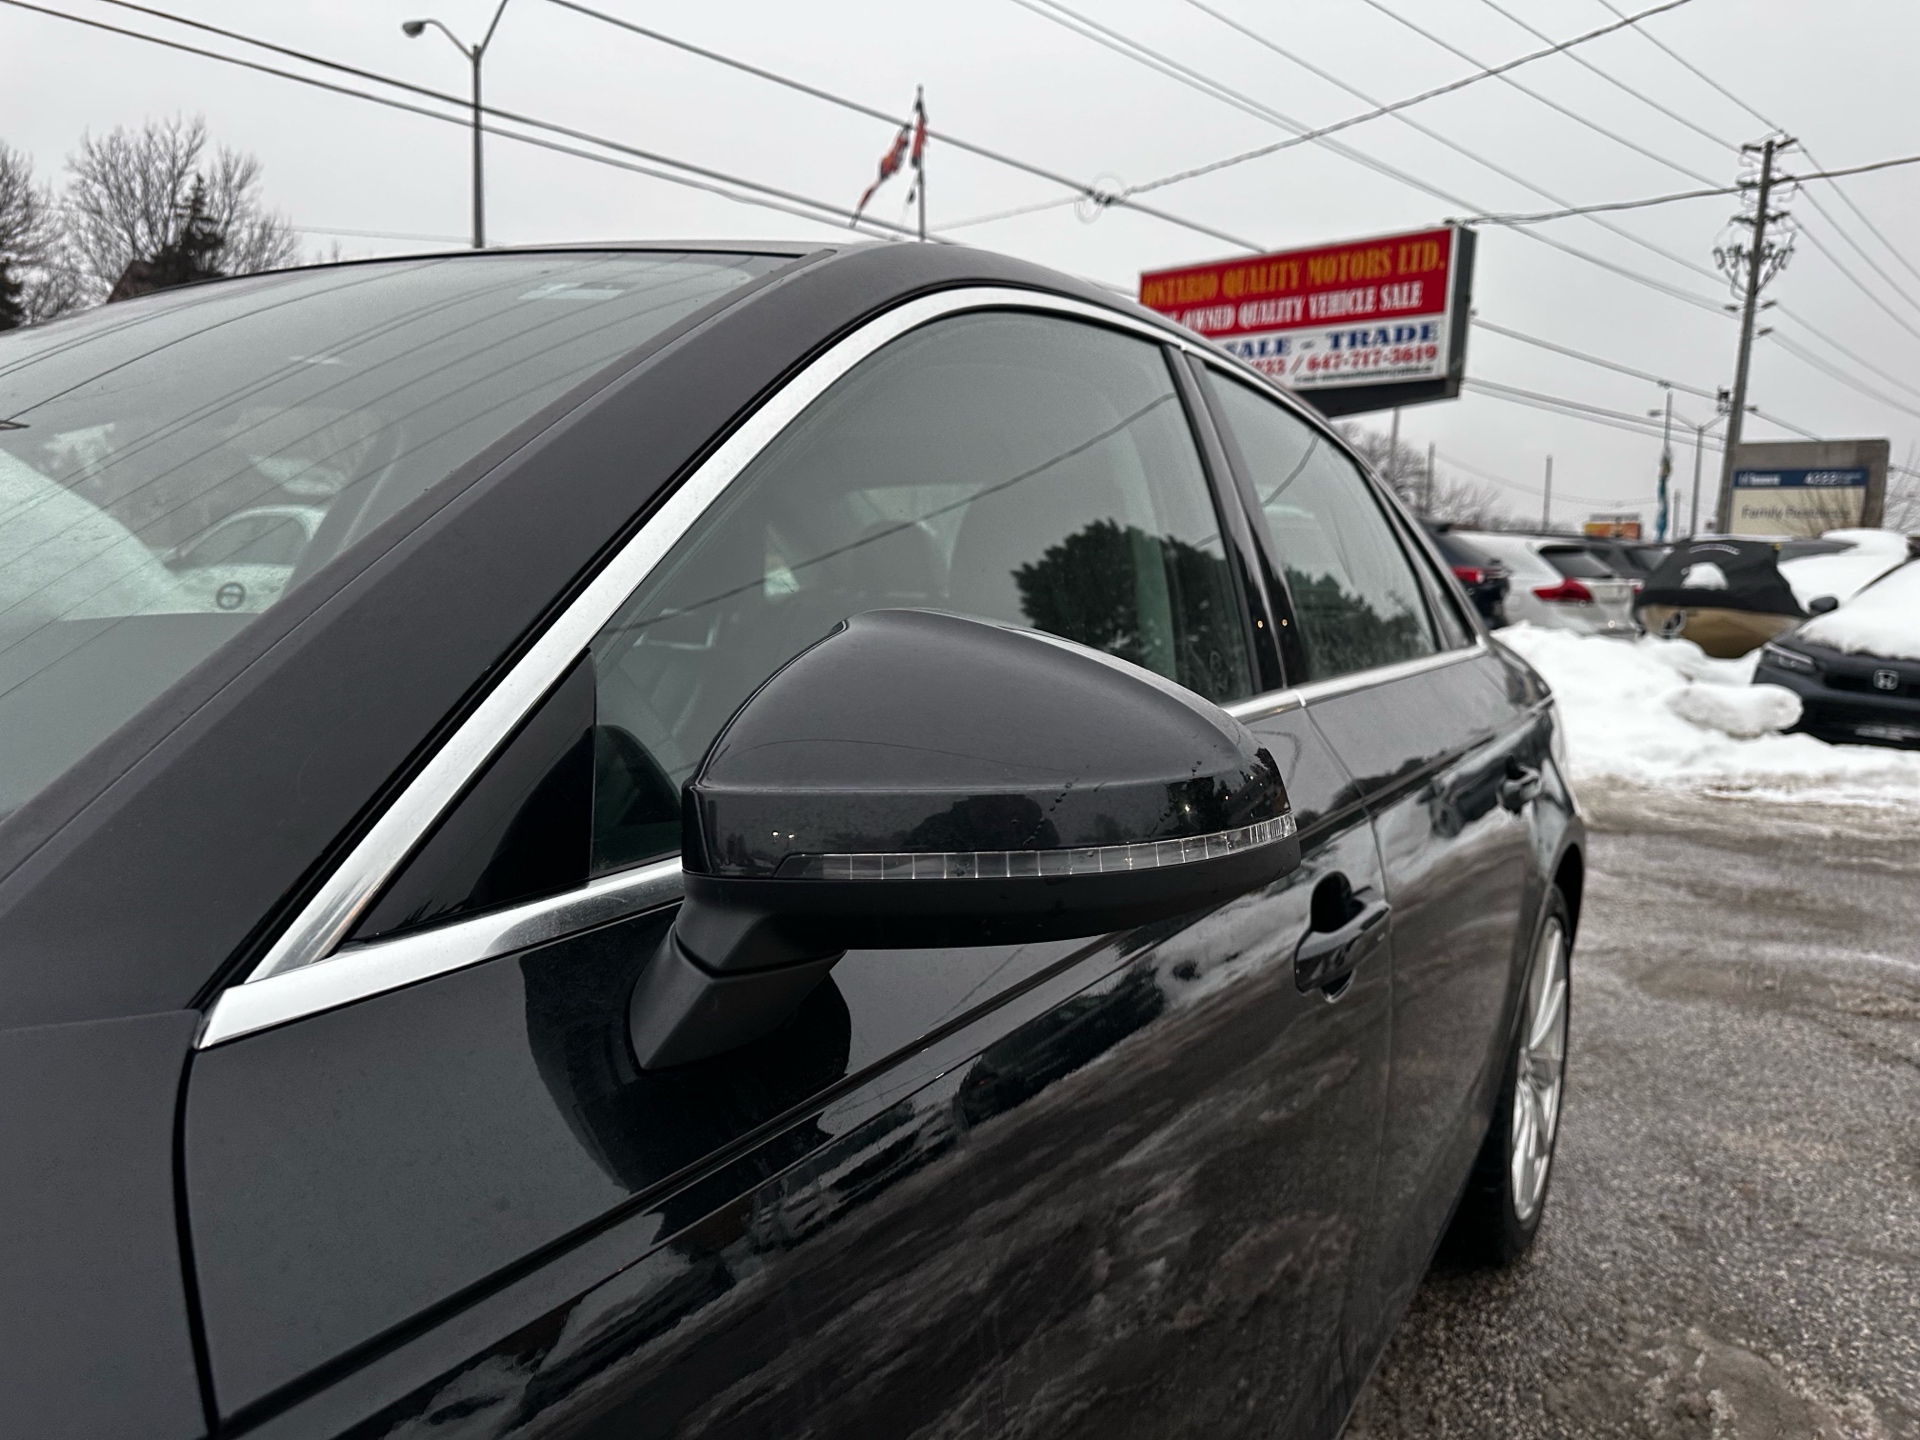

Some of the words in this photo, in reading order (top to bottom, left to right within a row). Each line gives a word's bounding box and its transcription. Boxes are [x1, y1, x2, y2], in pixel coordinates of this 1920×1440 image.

[1221, 259, 1302, 299] QUALITY
[1306, 244, 1393, 287] MOTORS
[1397, 239, 1446, 276] LTD.
[1237, 294, 1306, 330] QUALITY
[1308, 285, 1378, 320] VEHICLE
[1378, 280, 1424, 312] SALE
[1326, 321, 1440, 351] TRADE
